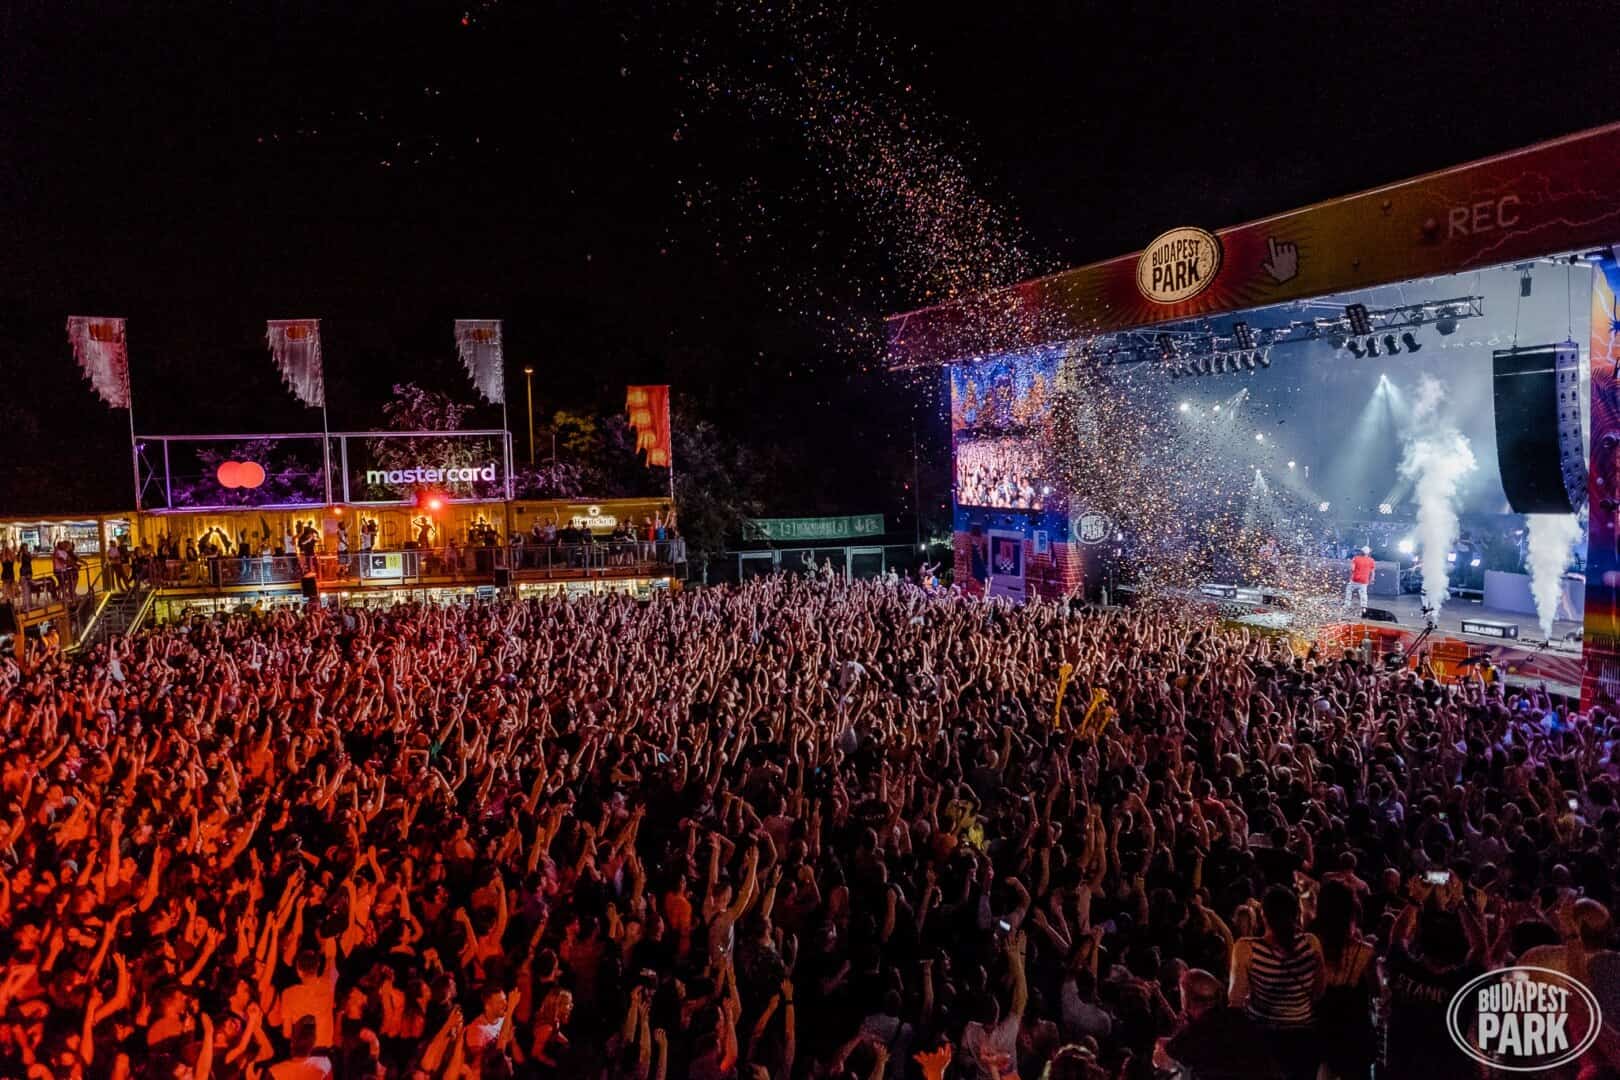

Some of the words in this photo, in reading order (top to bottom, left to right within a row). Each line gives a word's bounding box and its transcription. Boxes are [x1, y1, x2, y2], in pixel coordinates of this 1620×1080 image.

[1448, 195, 1520, 238] REC
[1152, 238, 1200, 266] BUDAPEST
[1152, 257, 1200, 293] PARK
[366, 463, 496, 484] mastercard
